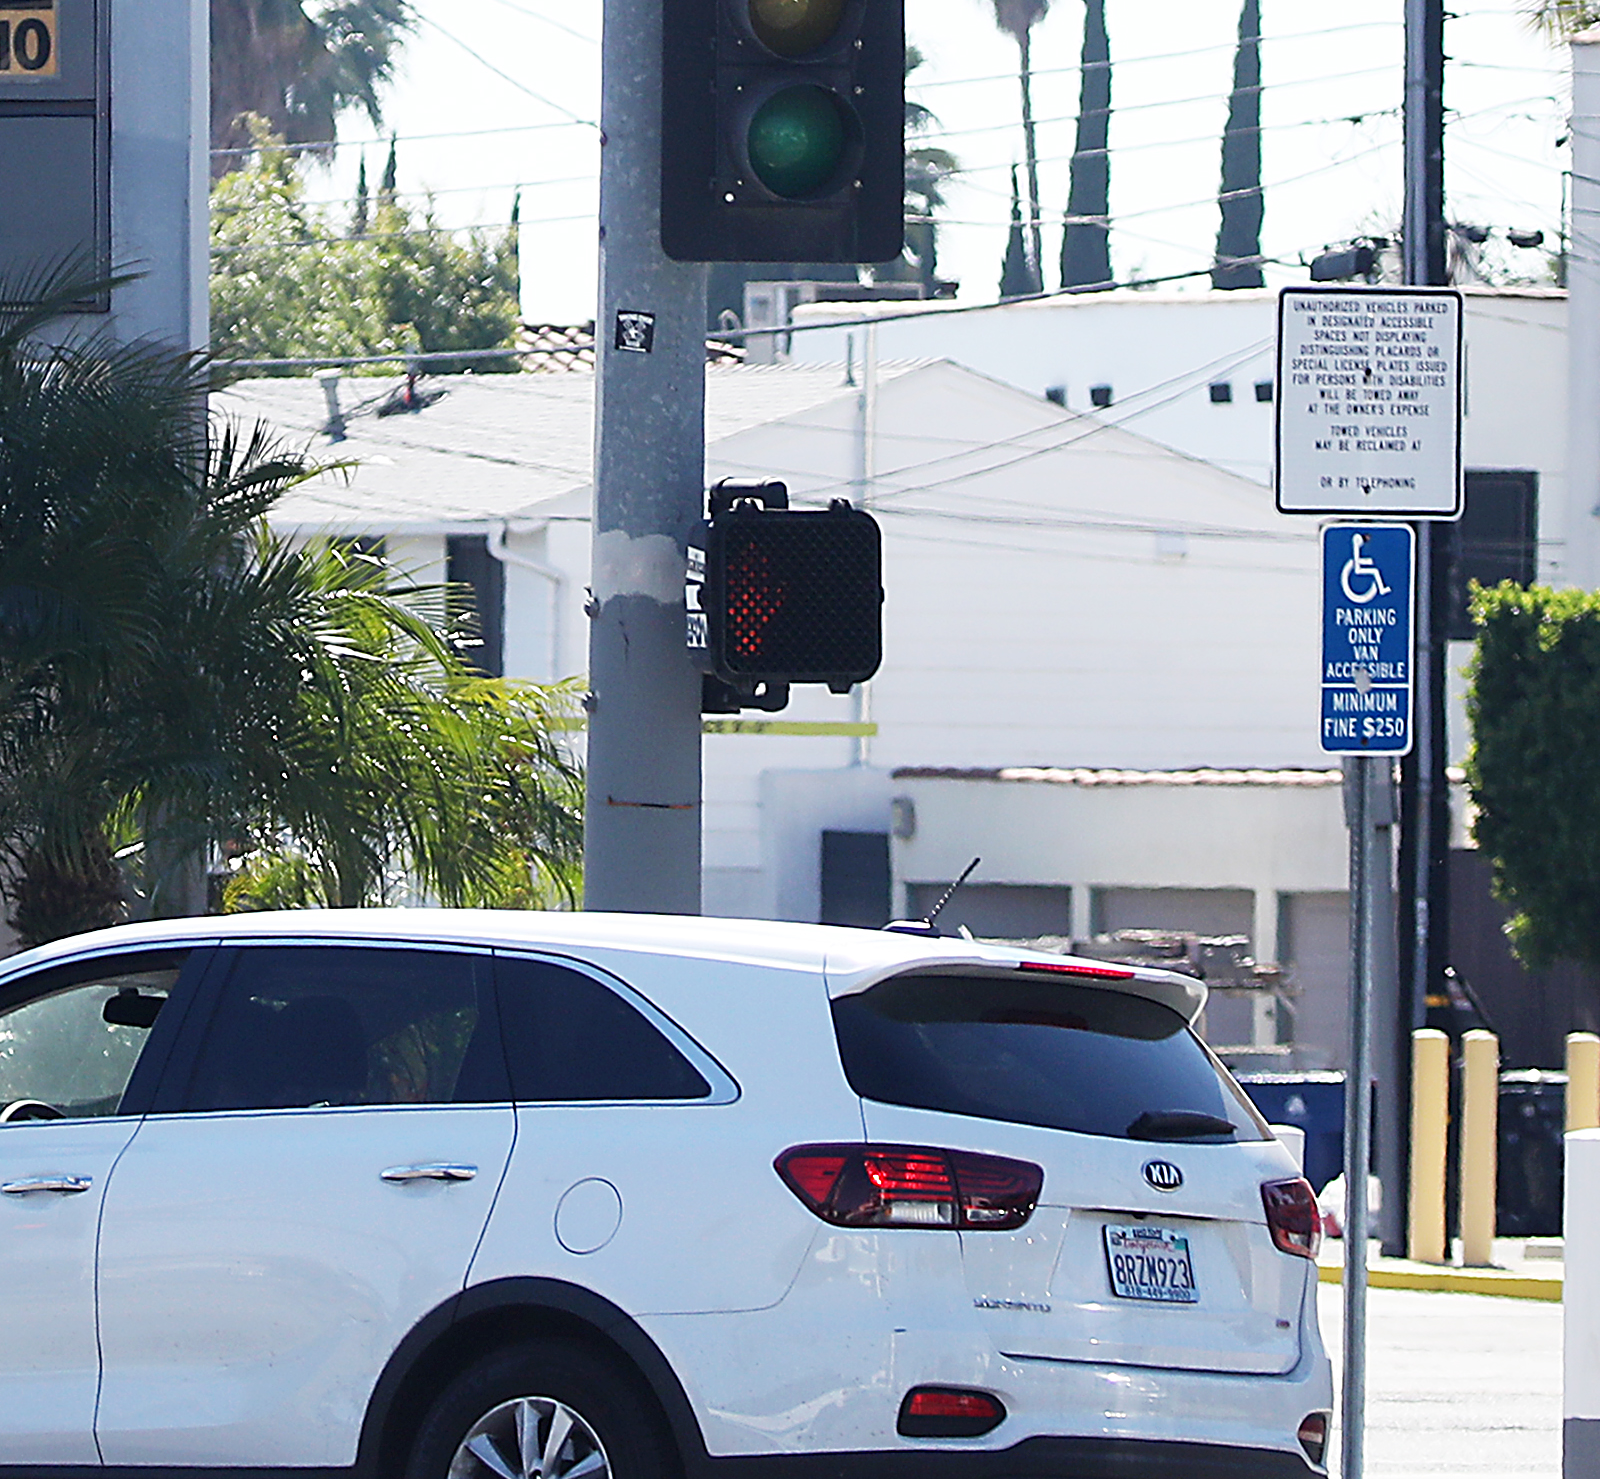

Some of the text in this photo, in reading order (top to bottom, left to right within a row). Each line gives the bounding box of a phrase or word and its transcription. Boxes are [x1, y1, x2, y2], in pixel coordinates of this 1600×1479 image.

[1366, 301, 1408, 313] VEHICLES
[1414, 301, 1448, 313] PARKED
[1322, 316, 1375, 328] DESIGNATED
[1381, 316, 1433, 328] ACCESSIBLE
[1314, 330, 1426, 342] SPACES NOT DISPLAYING
[1375, 345, 1422, 357] PLACARDS
[1428, 345, 1439, 357] OR
[1292, 359, 1328, 372] SPECIAL
[1376, 359, 1410, 372] PLATES
[1416, 359, 1448, 372] ISSUED
[1292, 374, 1309, 386] FOR
[1316, 374, 1356, 386] PERSONS
[1389, 374, 1445, 386] DISABILITIES
[1319, 389, 1418, 400] WILL BE TOWED AWAY
[1308, 404, 1318, 416] AT
[1324, 404, 1340, 416] THE
[1390, 404, 1429, 416] EXPENSE
[1330, 426, 1407, 436] TOWED VEHICLES
[1316, 440, 1421, 451] MAY BE RECLAIMED AT
[1320, 477, 1416, 489] OR BY TELEPHONING
[1336, 608, 1396, 626] PARKING
[1348, 627, 1383, 644] ONLY
[1353, 646, 1378, 661] VAN
[1333, 693, 1397, 712] MINIMUM
[1324, 718, 1357, 737] FINE
[1149, 1165, 1180, 1184] KIA
